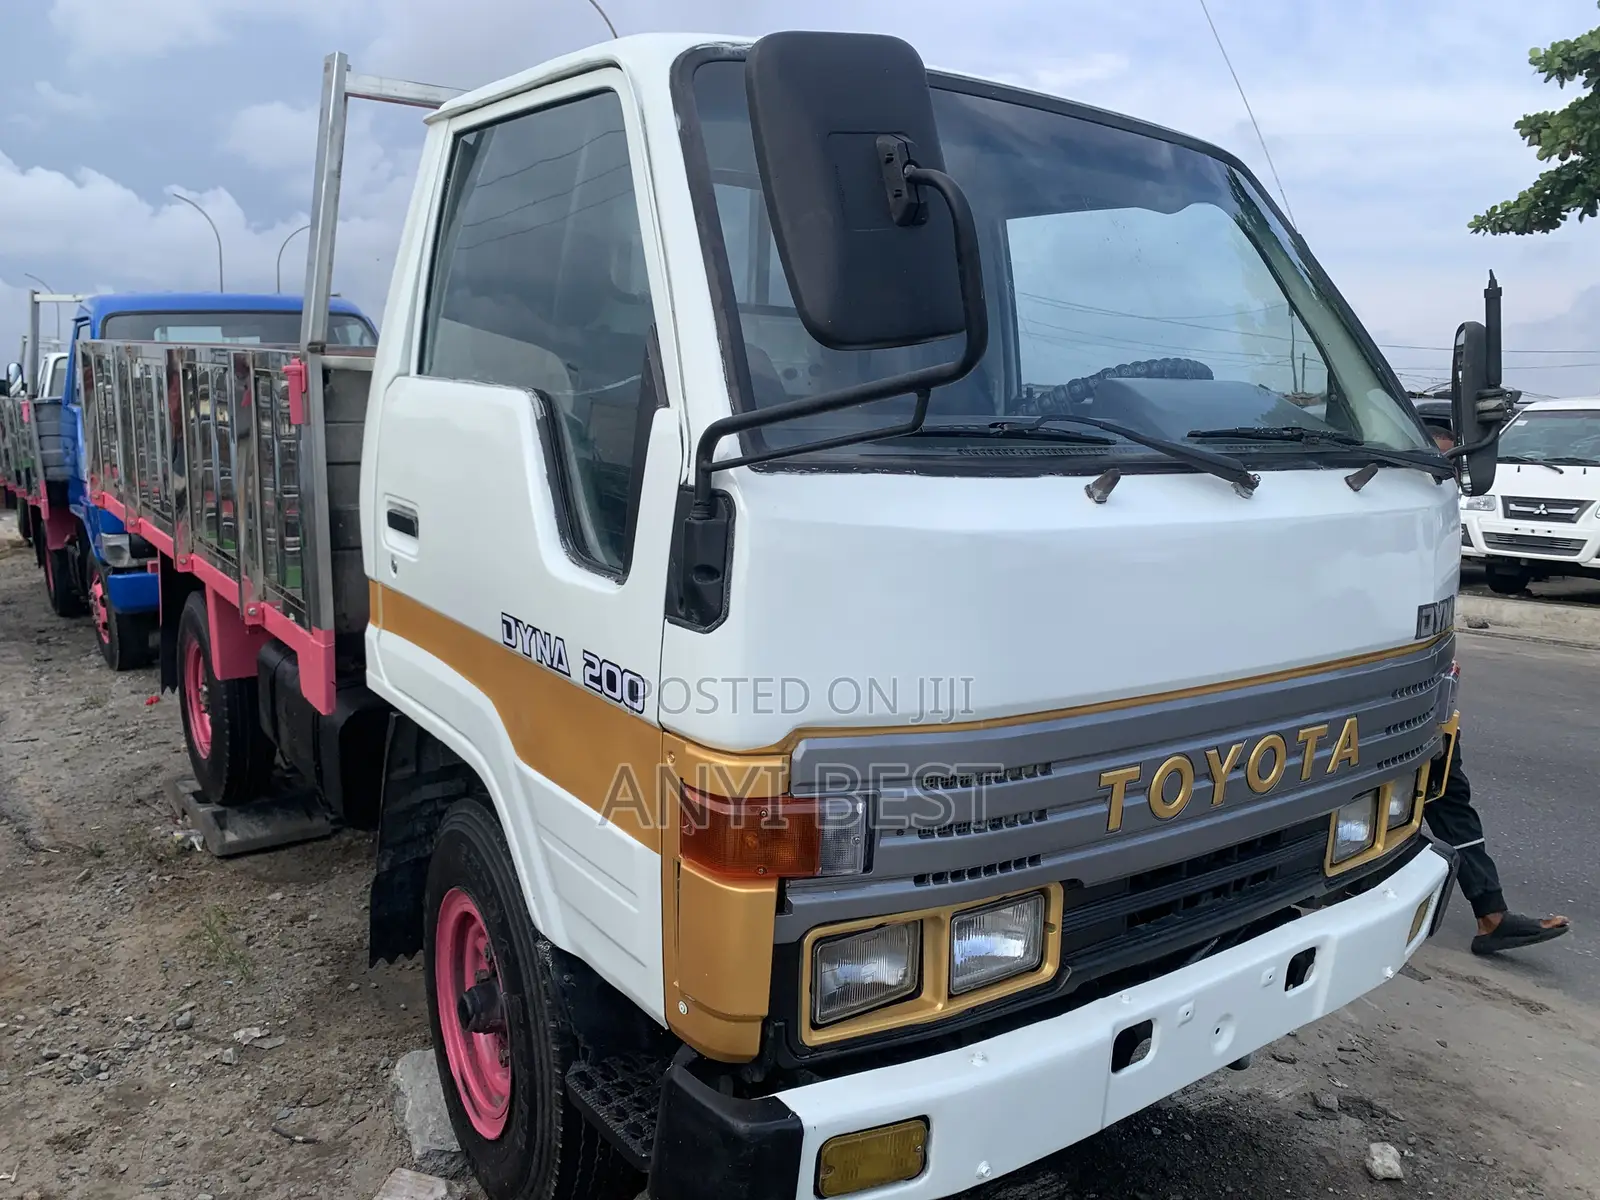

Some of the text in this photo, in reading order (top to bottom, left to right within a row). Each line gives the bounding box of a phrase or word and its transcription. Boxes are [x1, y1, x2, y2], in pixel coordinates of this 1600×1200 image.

[501, 612, 646, 715] DYNA 200
[1098, 716, 1360, 834] TOYOTA
